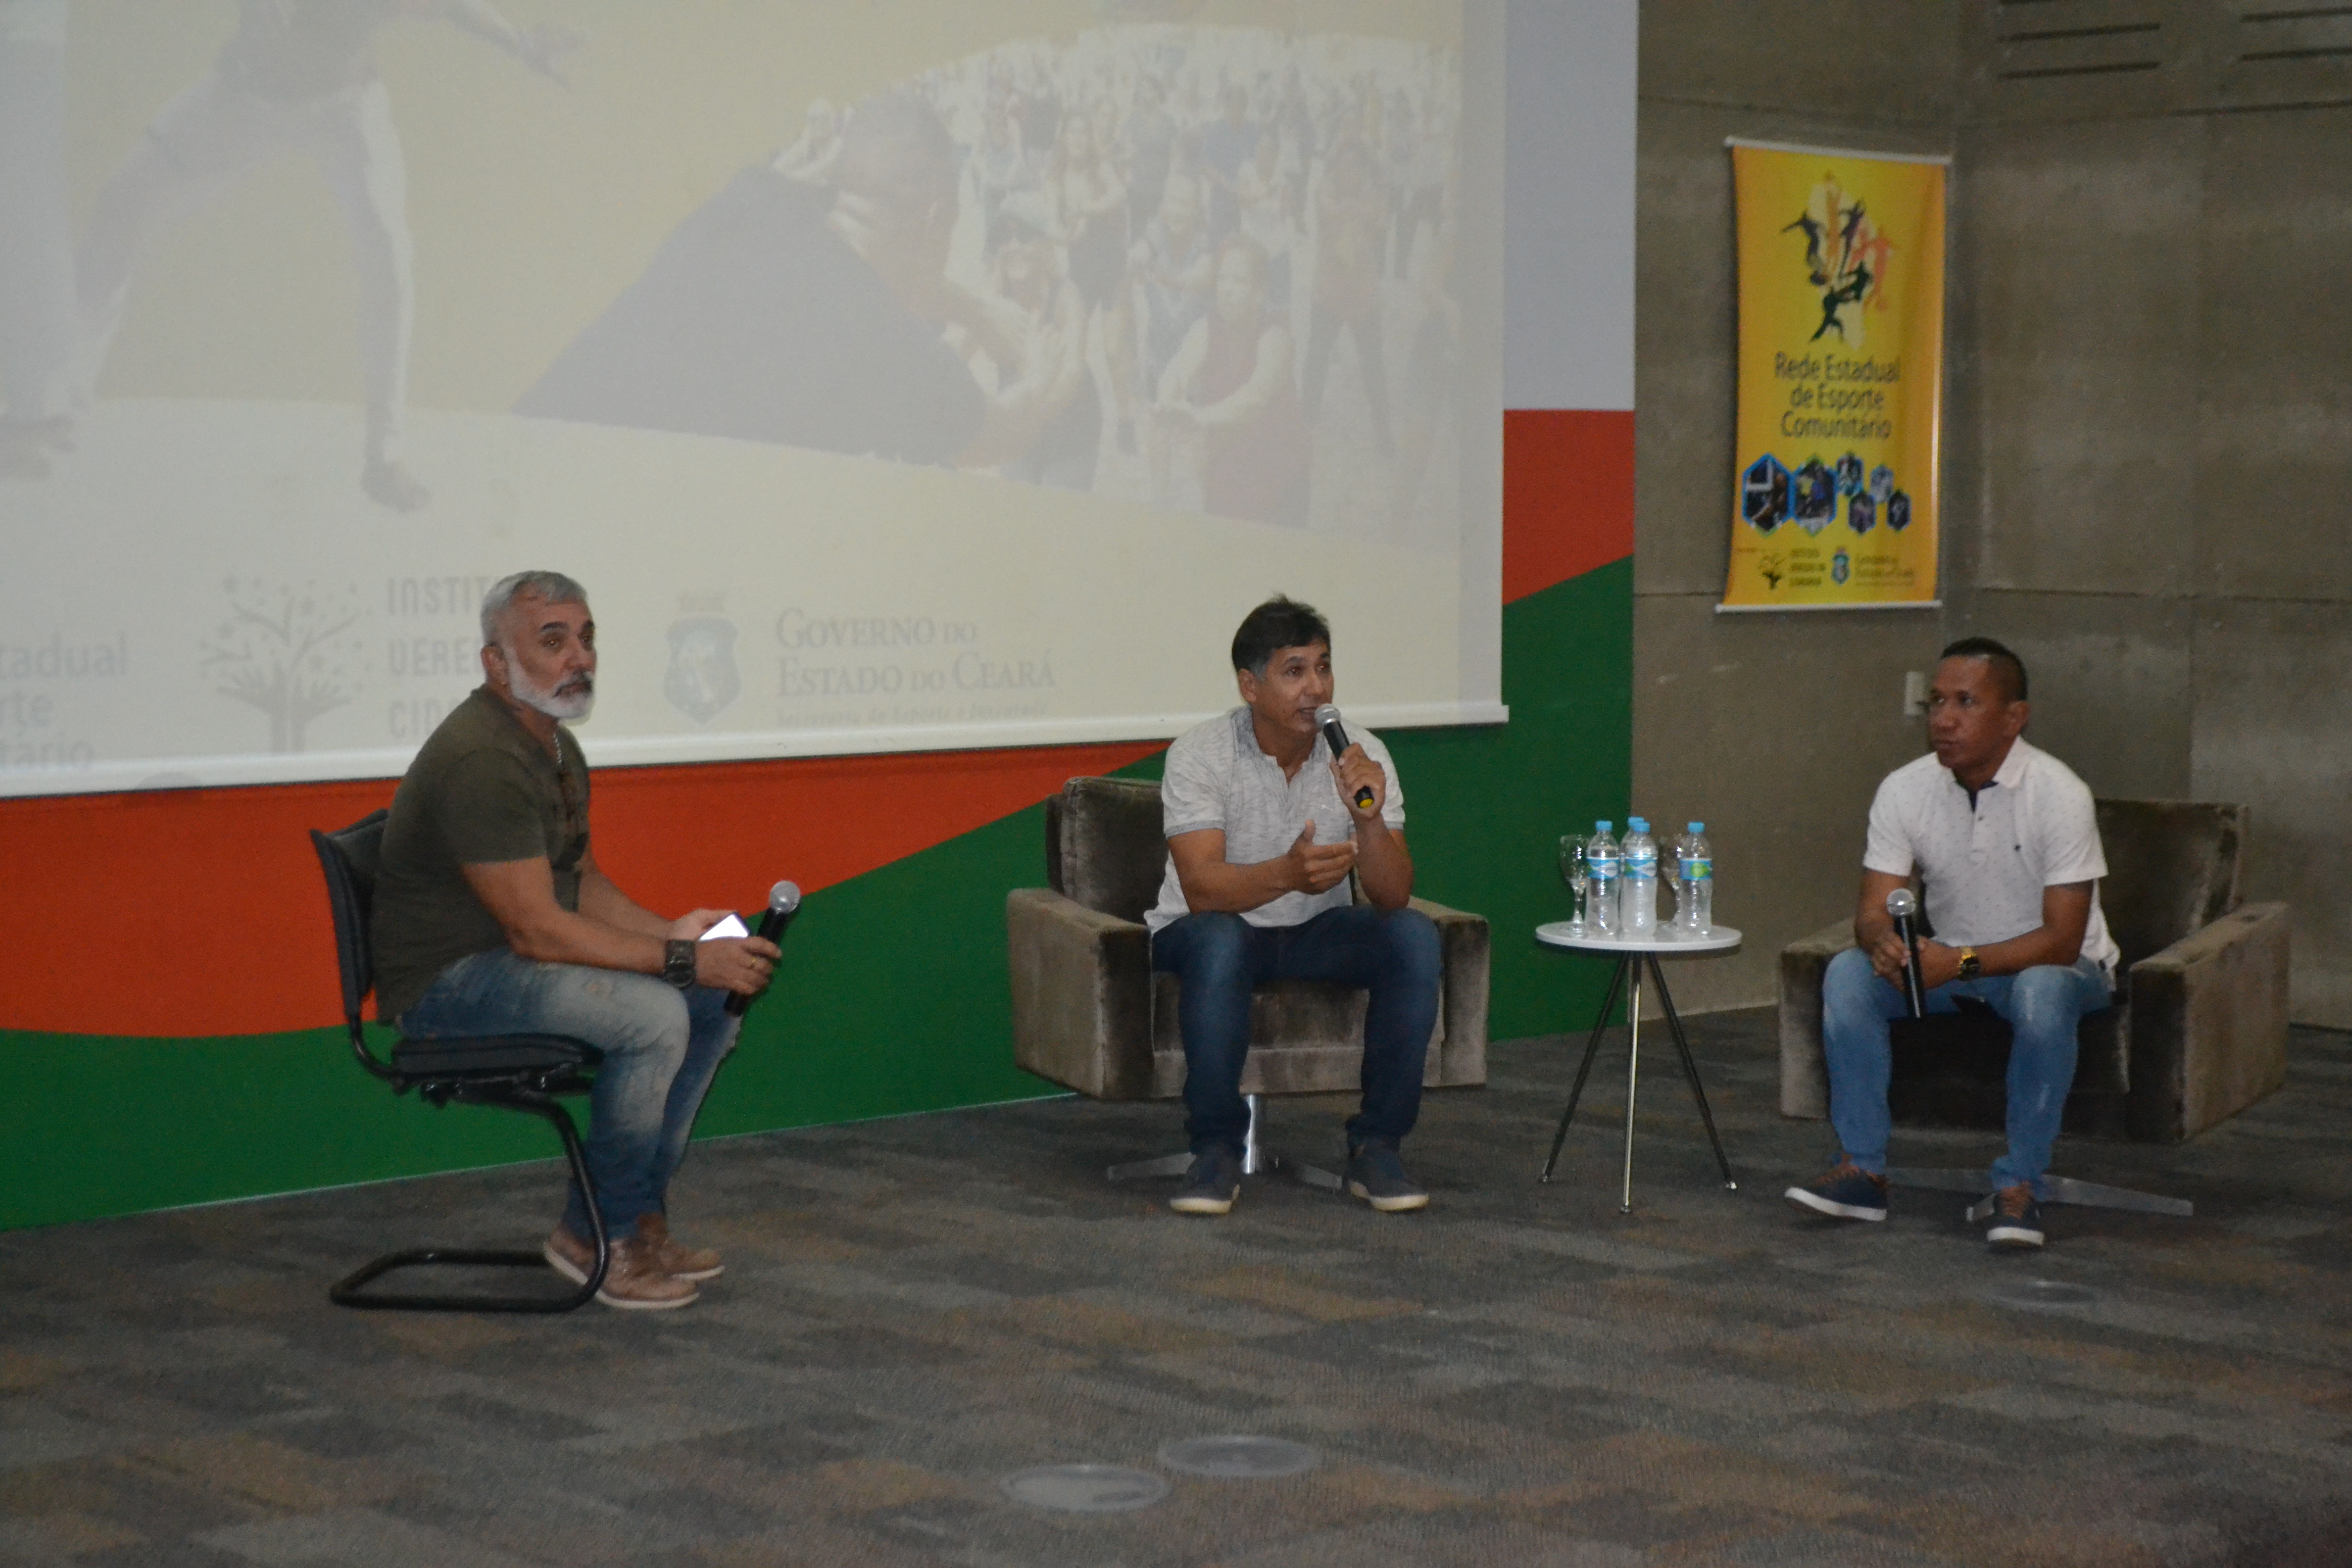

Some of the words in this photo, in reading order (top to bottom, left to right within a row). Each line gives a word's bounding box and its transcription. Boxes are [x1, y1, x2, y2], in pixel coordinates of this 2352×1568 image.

[1775, 351, 1820, 380] Rede
[1825, 353, 1901, 383] Estadual
[1790, 383, 1814, 408] de
[1818, 383, 1884, 414] Esporte
[1780, 410, 1892, 440] Comunitário
[387, 575, 495, 617] INSTIT
